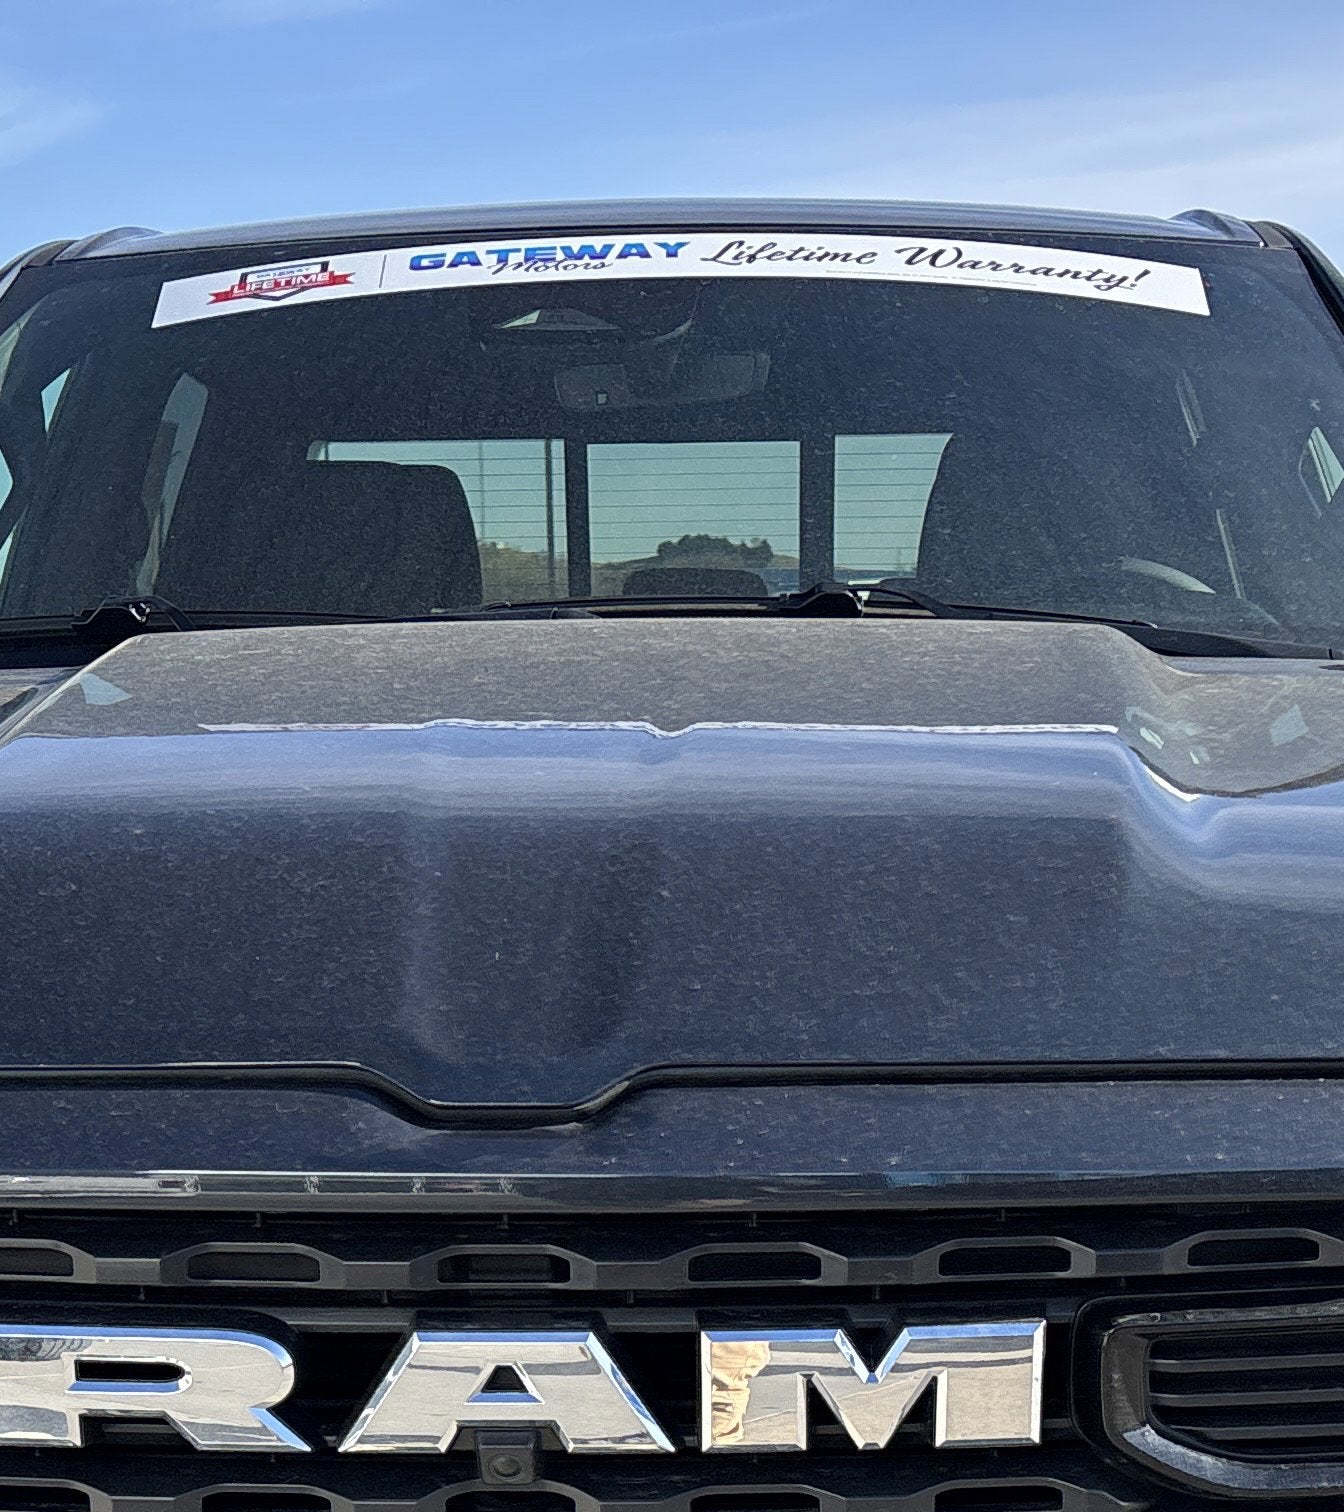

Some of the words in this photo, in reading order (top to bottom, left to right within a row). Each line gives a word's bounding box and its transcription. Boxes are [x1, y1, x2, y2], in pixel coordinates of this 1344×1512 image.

[409, 241, 691, 271] GATEWAY
[486, 256, 614, 275] Motors
[700, 240, 878, 266] Lifetime
[894, 246, 1152, 291] Warranty!
